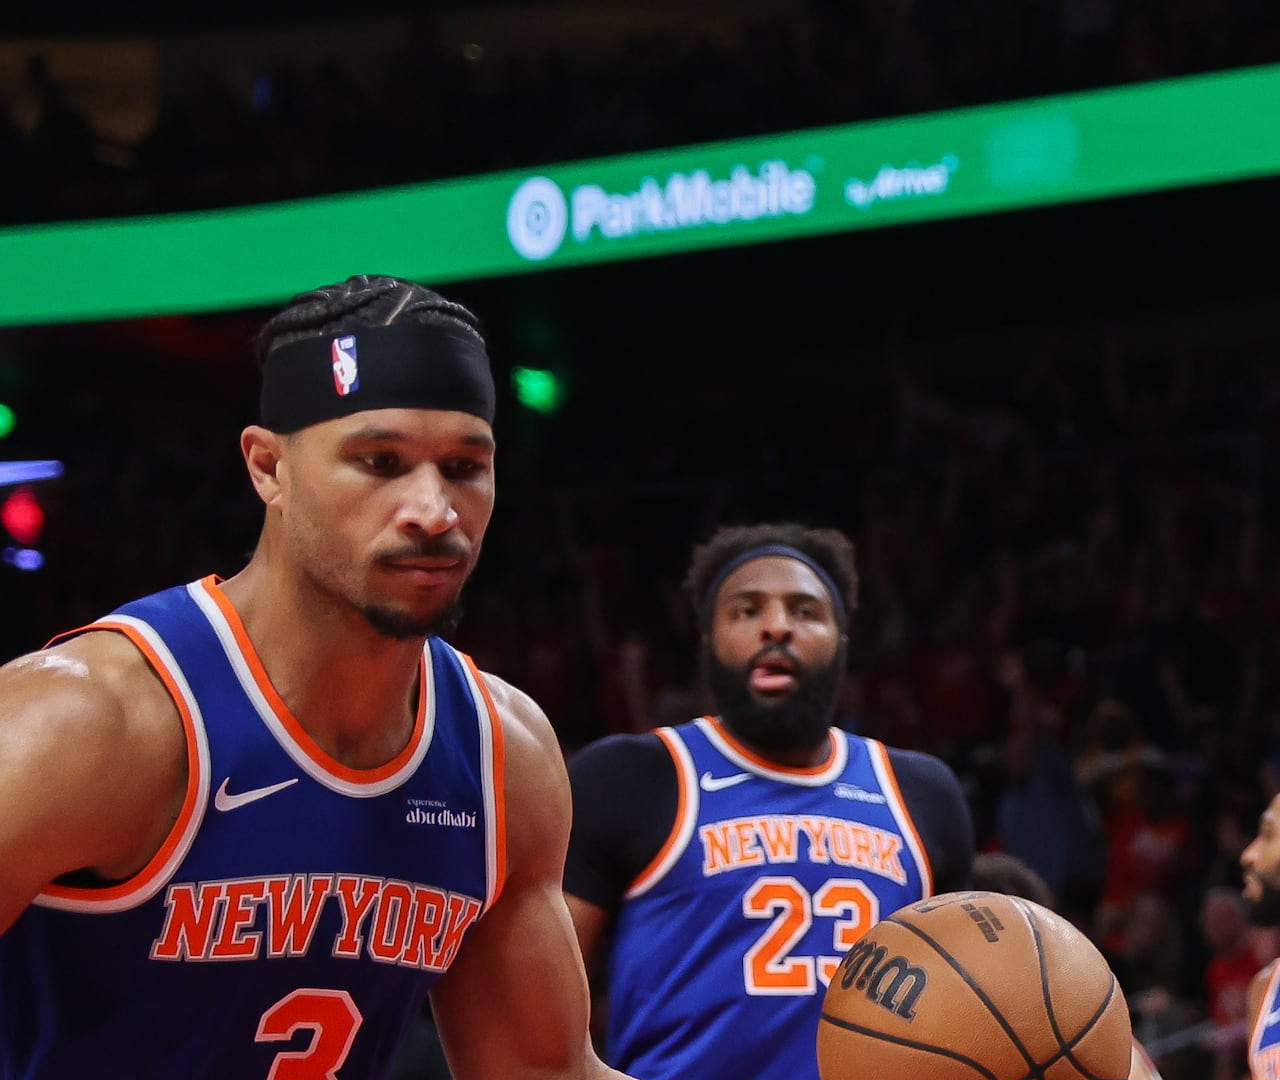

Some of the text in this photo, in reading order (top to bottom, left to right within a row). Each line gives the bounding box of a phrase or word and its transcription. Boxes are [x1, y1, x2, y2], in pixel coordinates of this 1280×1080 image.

[571, 158, 816, 243] ParkMobile
[405, 807, 477, 828] abu dhabi
[699, 814, 908, 887] NEW YORK
[150, 871, 484, 973] NEW YORK
[742, 875, 880, 997] 23
[841, 939, 928, 1024] Wil
